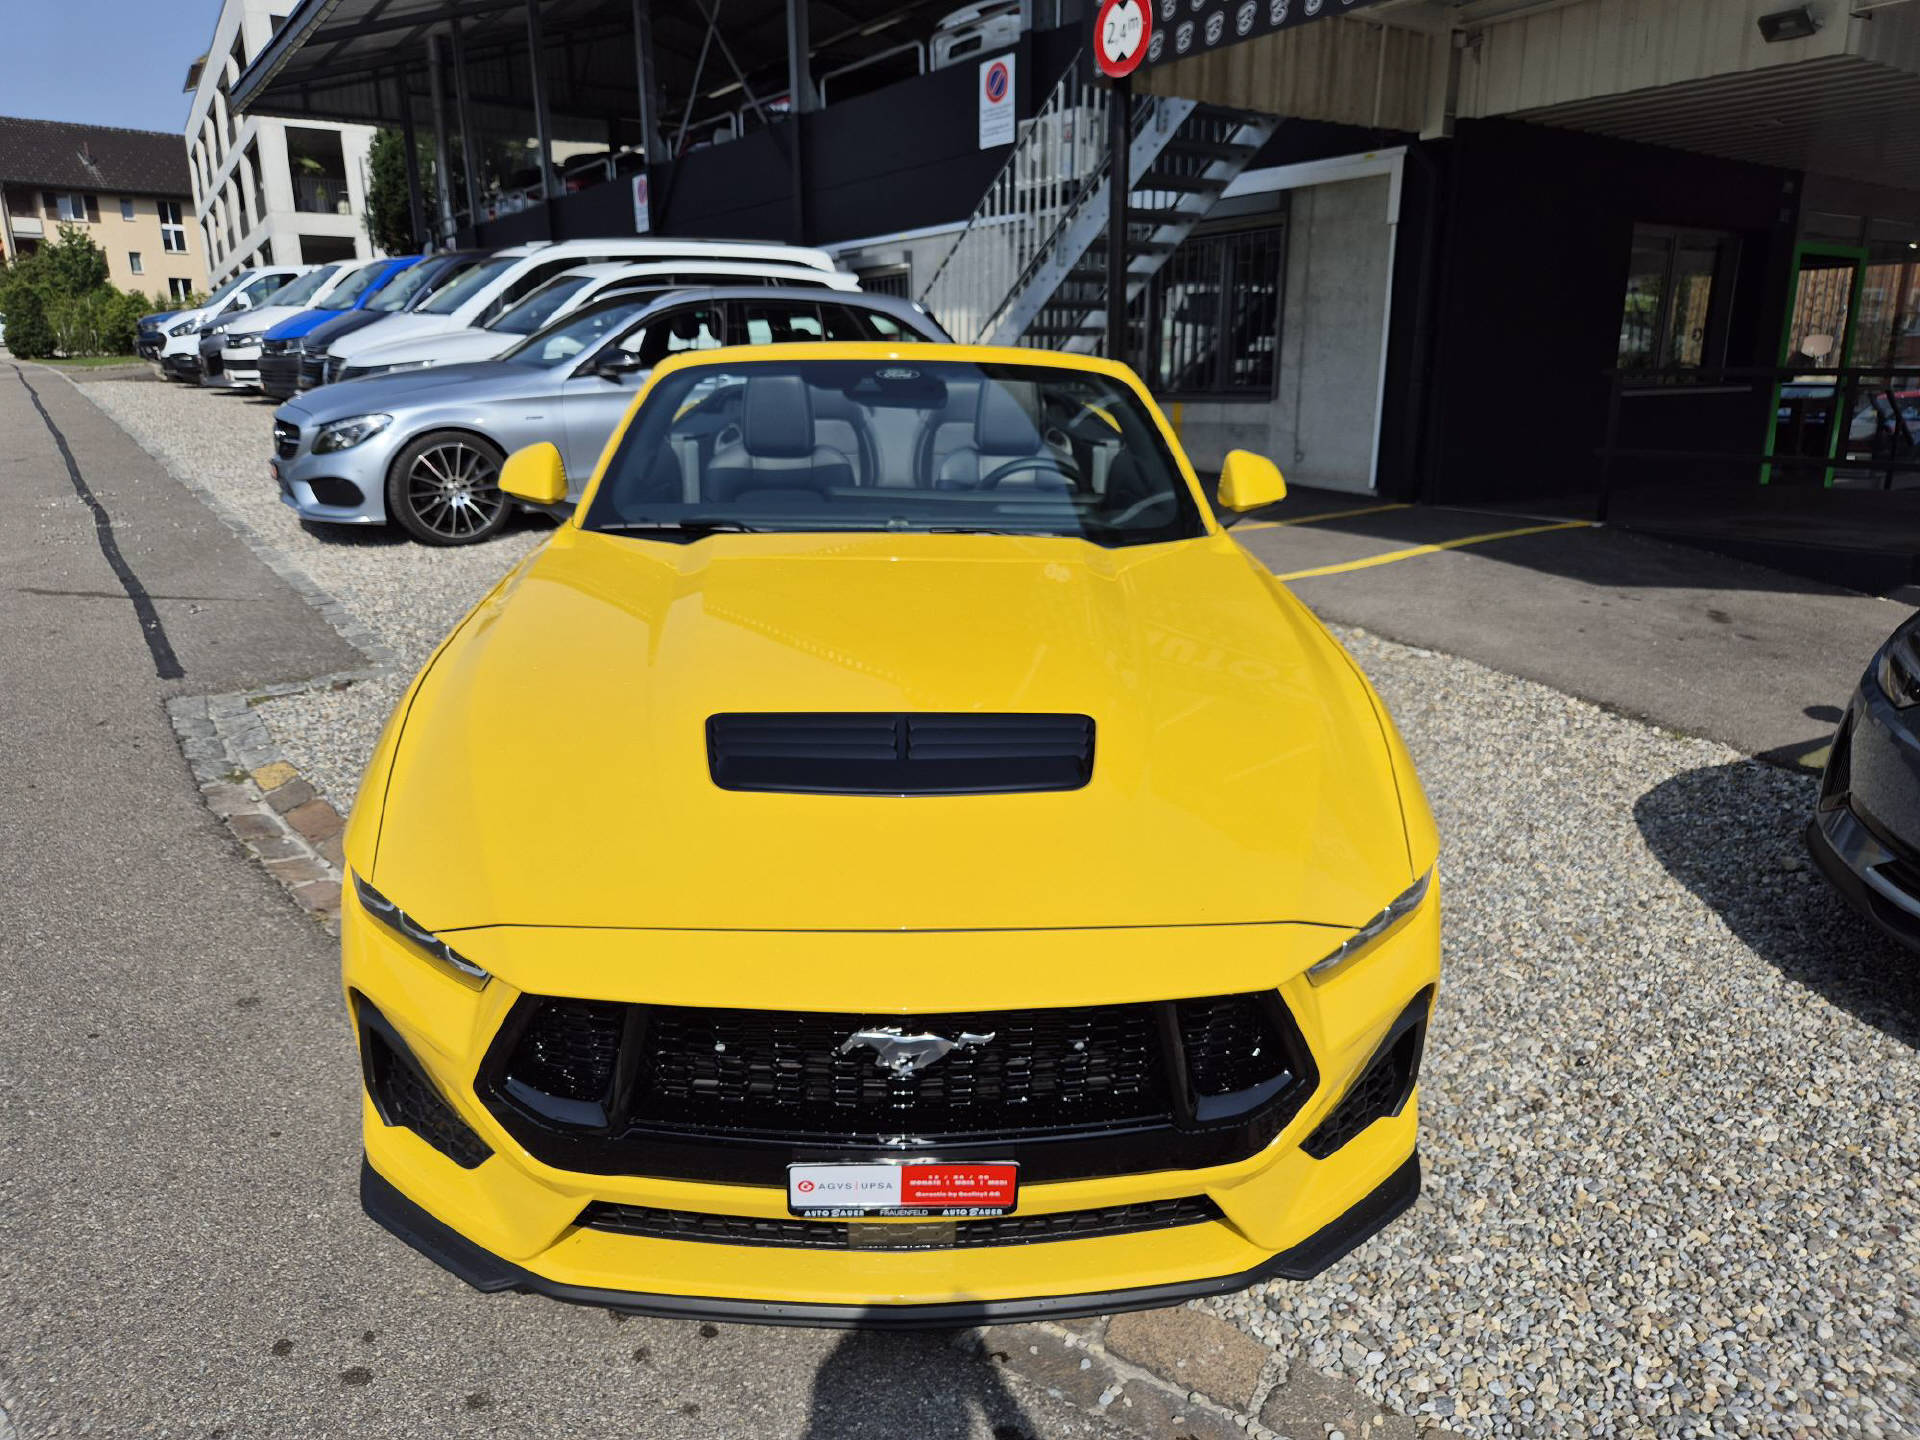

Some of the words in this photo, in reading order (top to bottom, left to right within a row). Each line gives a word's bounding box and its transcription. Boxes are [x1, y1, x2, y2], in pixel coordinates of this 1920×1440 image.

[818, 1182, 853, 1190] AGVS
[861, 1181, 893, 1190] UPSA
[804, 1209, 830, 1217] AUTO
[879, 1208, 929, 1217] FRAUENFELD
[942, 1208, 968, 1216] AUTO
